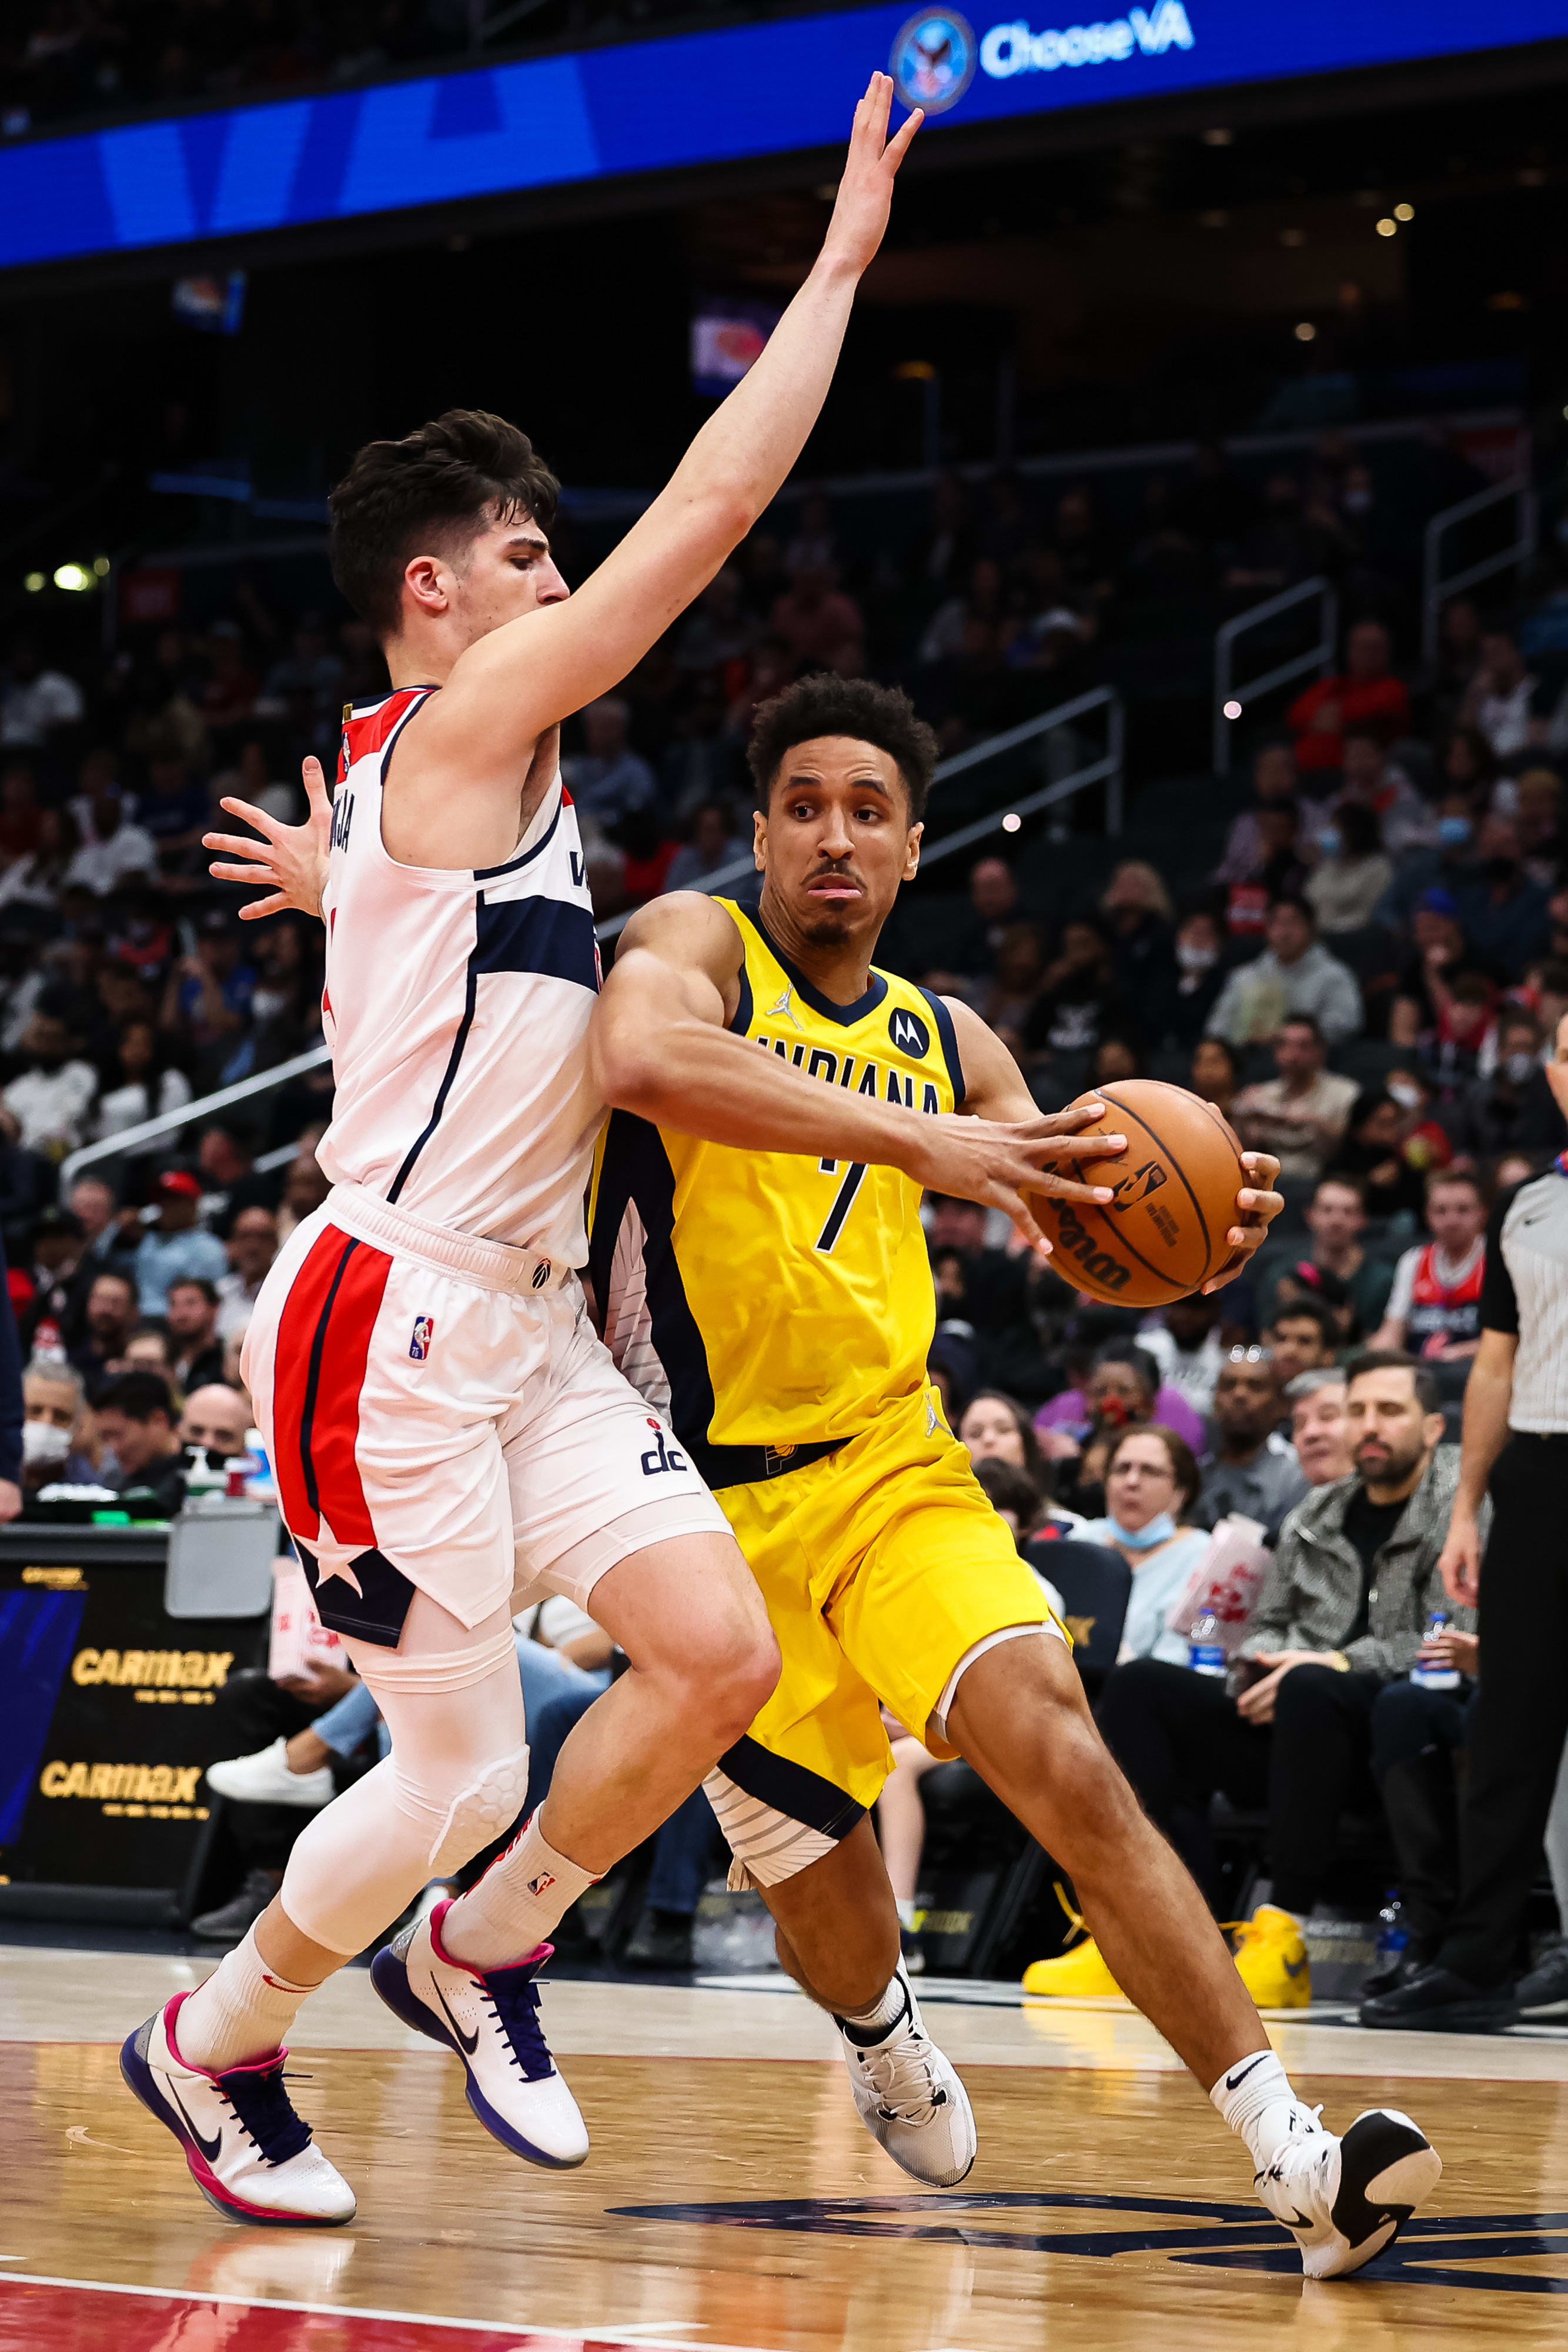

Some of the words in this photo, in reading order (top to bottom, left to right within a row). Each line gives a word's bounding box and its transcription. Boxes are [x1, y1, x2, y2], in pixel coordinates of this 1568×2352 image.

[756, 1035, 940, 1115] DIANA
[813, 1155, 869, 1254] 7
[1042, 1161, 1132, 1292] Wils
